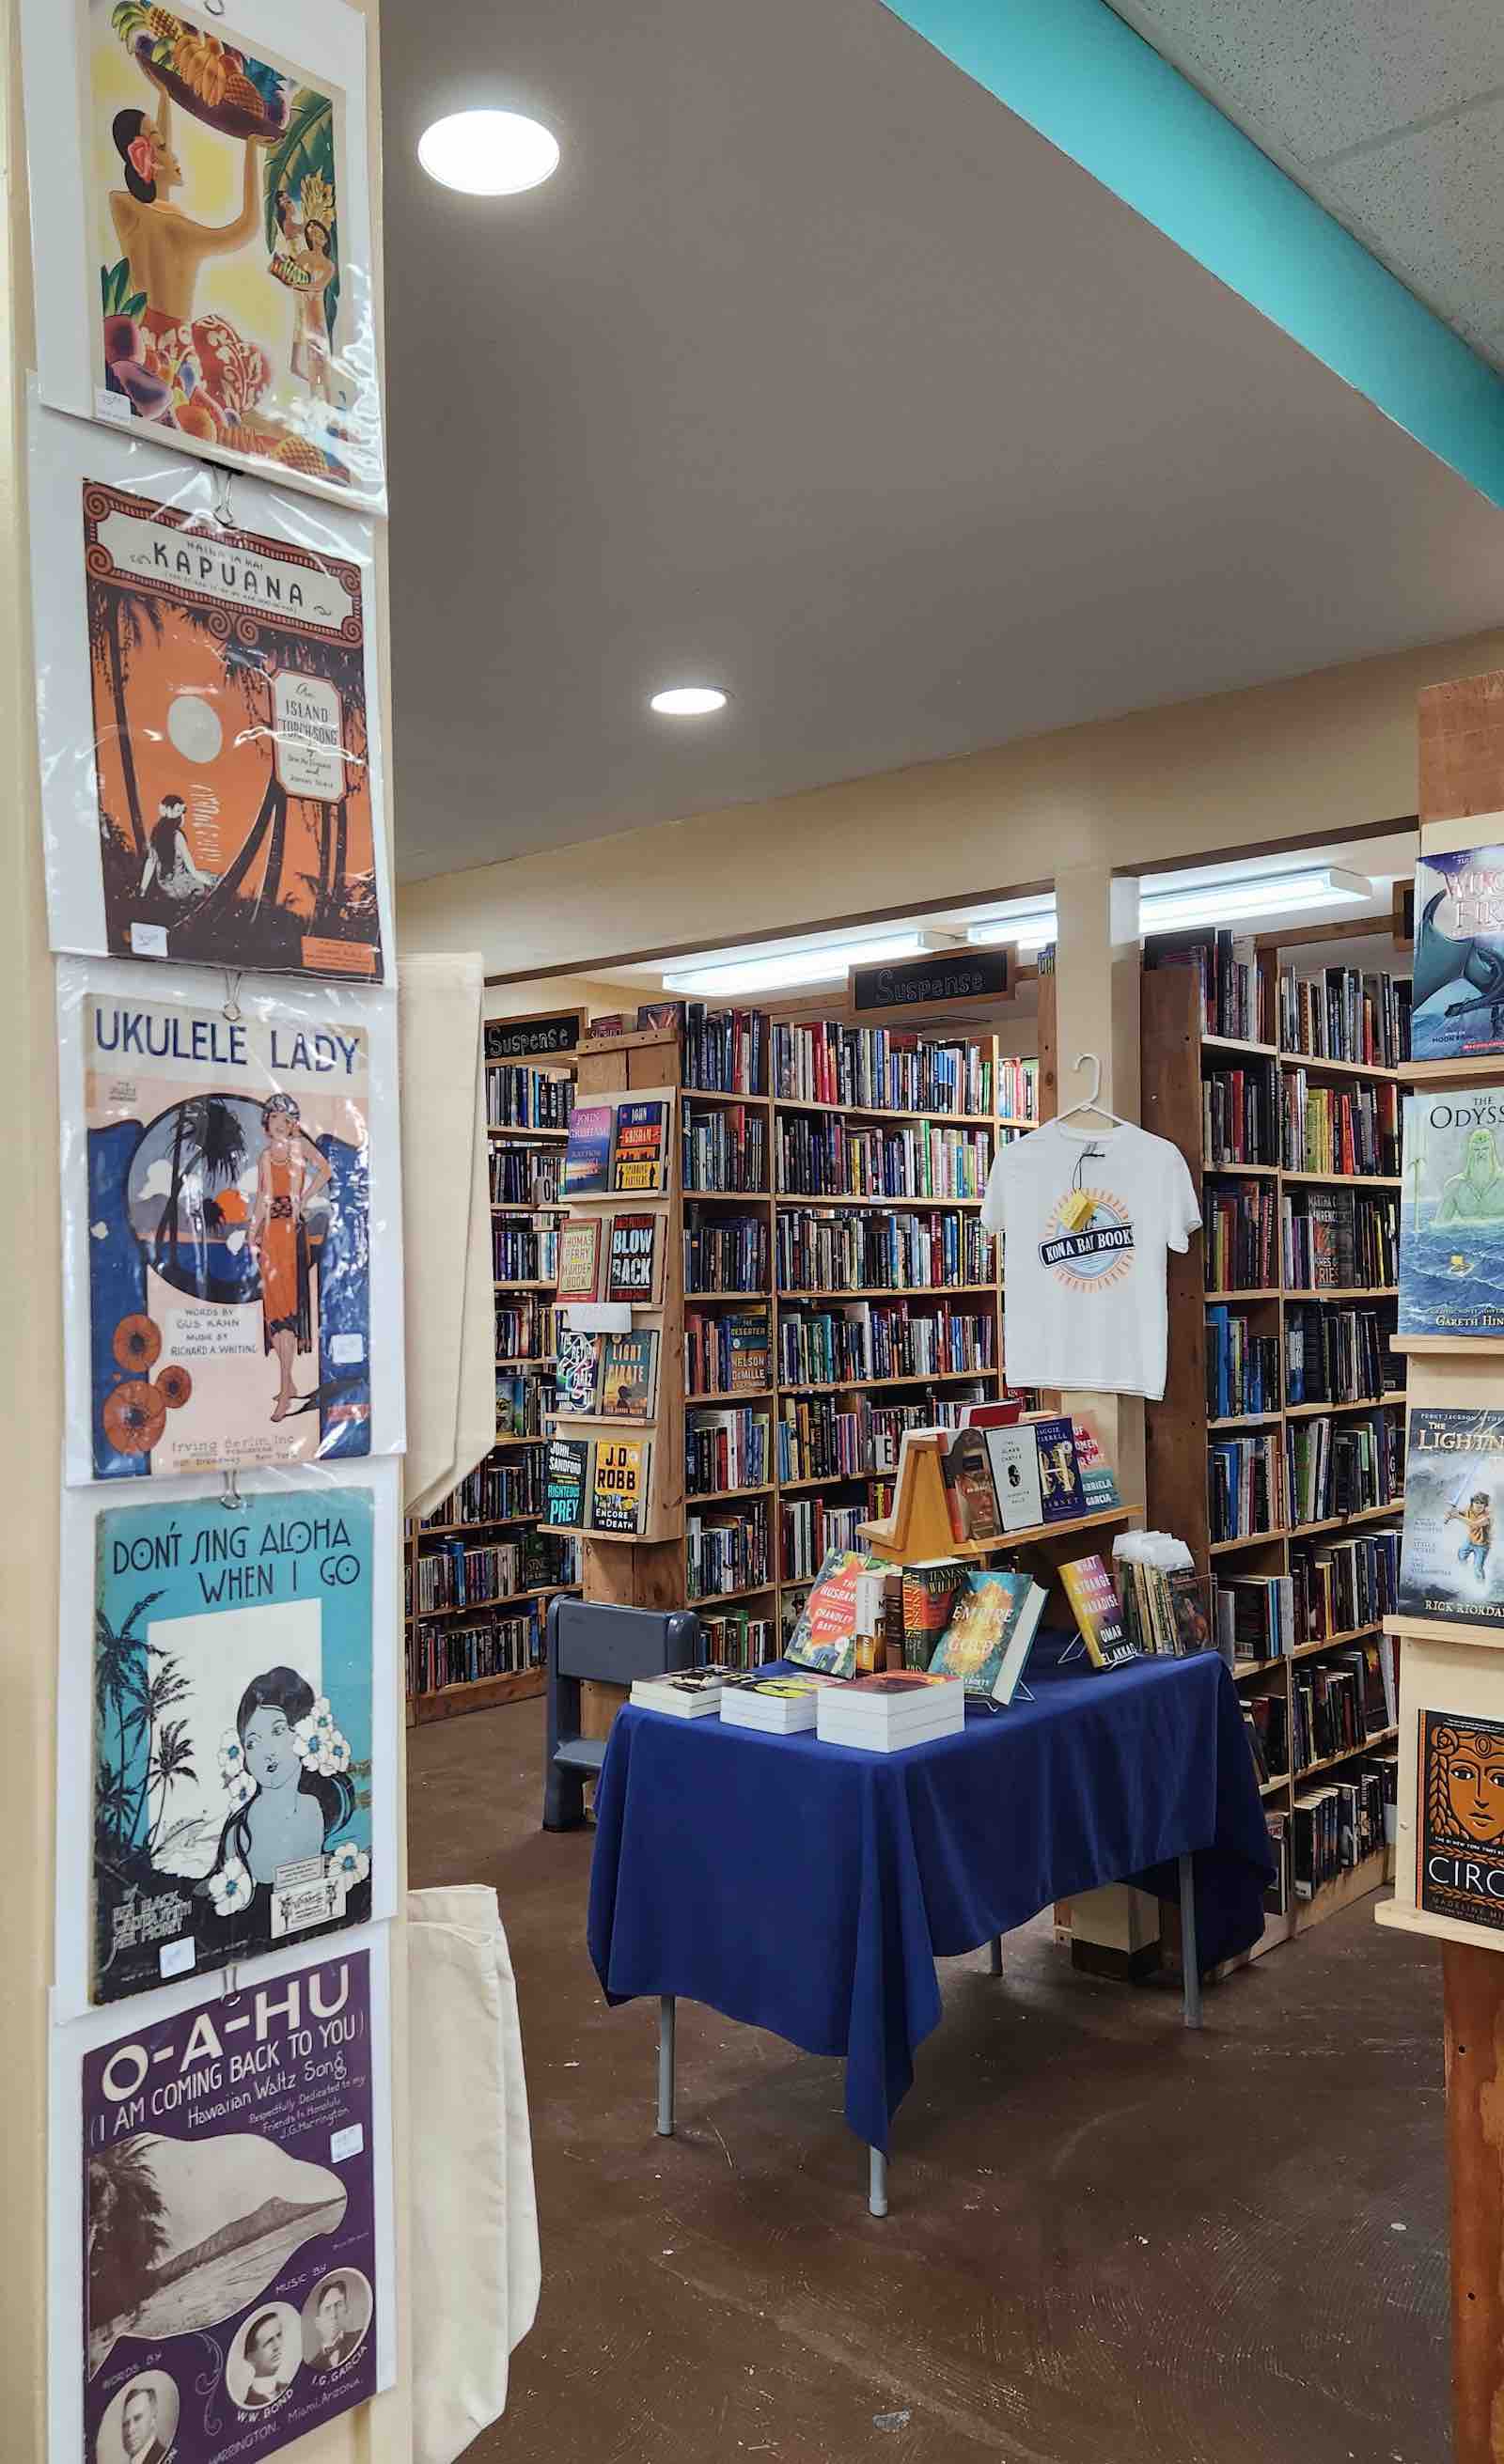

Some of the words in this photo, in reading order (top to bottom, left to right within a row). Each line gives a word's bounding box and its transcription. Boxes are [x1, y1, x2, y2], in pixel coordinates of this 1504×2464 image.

[153, 540, 304, 607] KAPUANA
[285, 698, 329, 724] ISLAND
[877, 969, 986, 1002] Suspense
[95, 1007, 248, 1066] UKULELE
[270, 1029, 360, 1075] LADY
[488, 1022, 570, 1057] Suspense
[1473, 1097, 1495, 1106] THE
[632, 1107, 648, 1125] JOHN
[613, 1228, 653, 1255] BLOW
[1044, 1240, 1074, 1263] KONA
[1075, 1234, 1095, 1253] BAY
[1097, 1225, 1136, 1251] BOOKS
[611, 1257, 651, 1286] BACK
[1435, 1315, 1479, 1327] GARETH
[1428, 1421, 1446, 1430] THE
[549, 1441, 571, 1458] JOHN
[548, 1456, 582, 1475] SANDFORD
[598, 1468, 636, 1490] ROBB
[549, 1498, 580, 1524] PREY
[1085, 1493, 1112, 1505] GARCIA
[595, 1507, 629, 1520] ENCORE
[606, 1518, 634, 1529] DEATH
[113, 1521, 183, 1575] DON'T
[189, 1525, 251, 1565] SING
[259, 1518, 352, 1556] ALOHA
[197, 1563, 274, 1604] WHEN
[291, 1559, 298, 1592] I
[320, 1554, 361, 1586] GO
[1423, 1599, 1453, 1612] RICK
[1099, 1624, 1123, 1643] OMAR
[102, 1963, 350, 2102] O-A-HU
[113, 2097, 145, 2136] AM
[151, 2063, 223, 2116] COMING
[229, 2040, 280, 2083] BACK
[287, 2029, 313, 2060] TO
[188, 2090, 253, 2129] Hawaiian
[254, 2068, 297, 2100] Waltz
[304, 2050, 347, 2082] Song
[300, 2082, 339, 2105] Dedicated
[274, 2272, 307, 2296] MUSIC
[312, 2263, 327, 2277] BY
[330, 2346, 368, 2383] GARCIA
[263, 2388, 294, 2421] BOND
